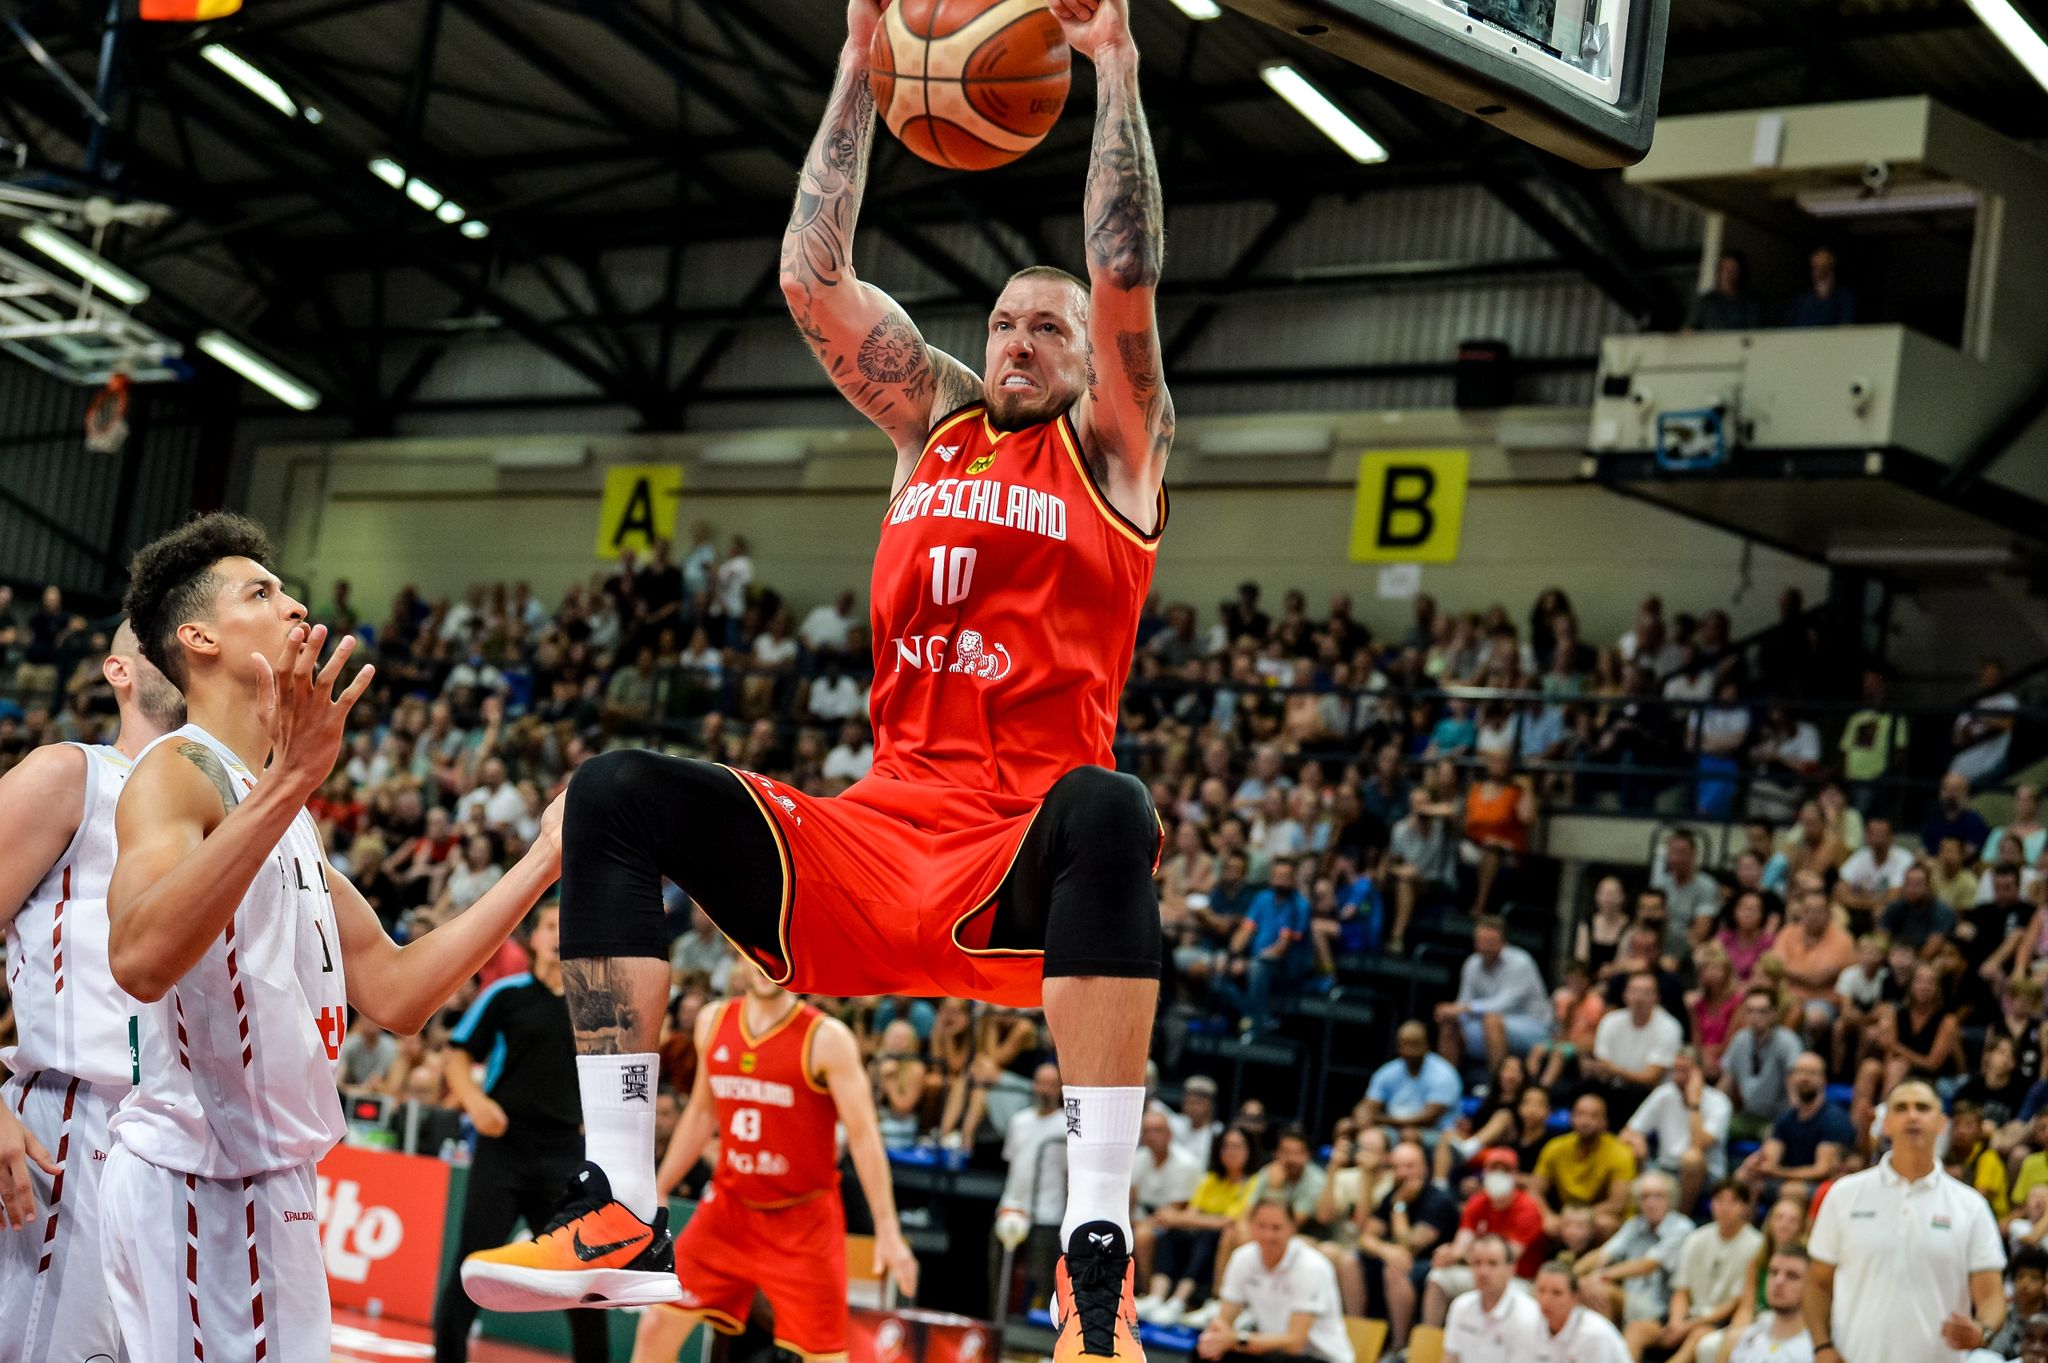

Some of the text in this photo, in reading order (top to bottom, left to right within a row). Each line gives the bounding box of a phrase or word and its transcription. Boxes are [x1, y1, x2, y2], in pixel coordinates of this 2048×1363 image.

[613, 476, 656, 547] A
[1377, 464, 1436, 548] B
[929, 545, 977, 606] 10
[621, 1064, 649, 1103] PEAK
[730, 1108, 761, 1142] 43
[1066, 1097, 1081, 1138] PEAK
